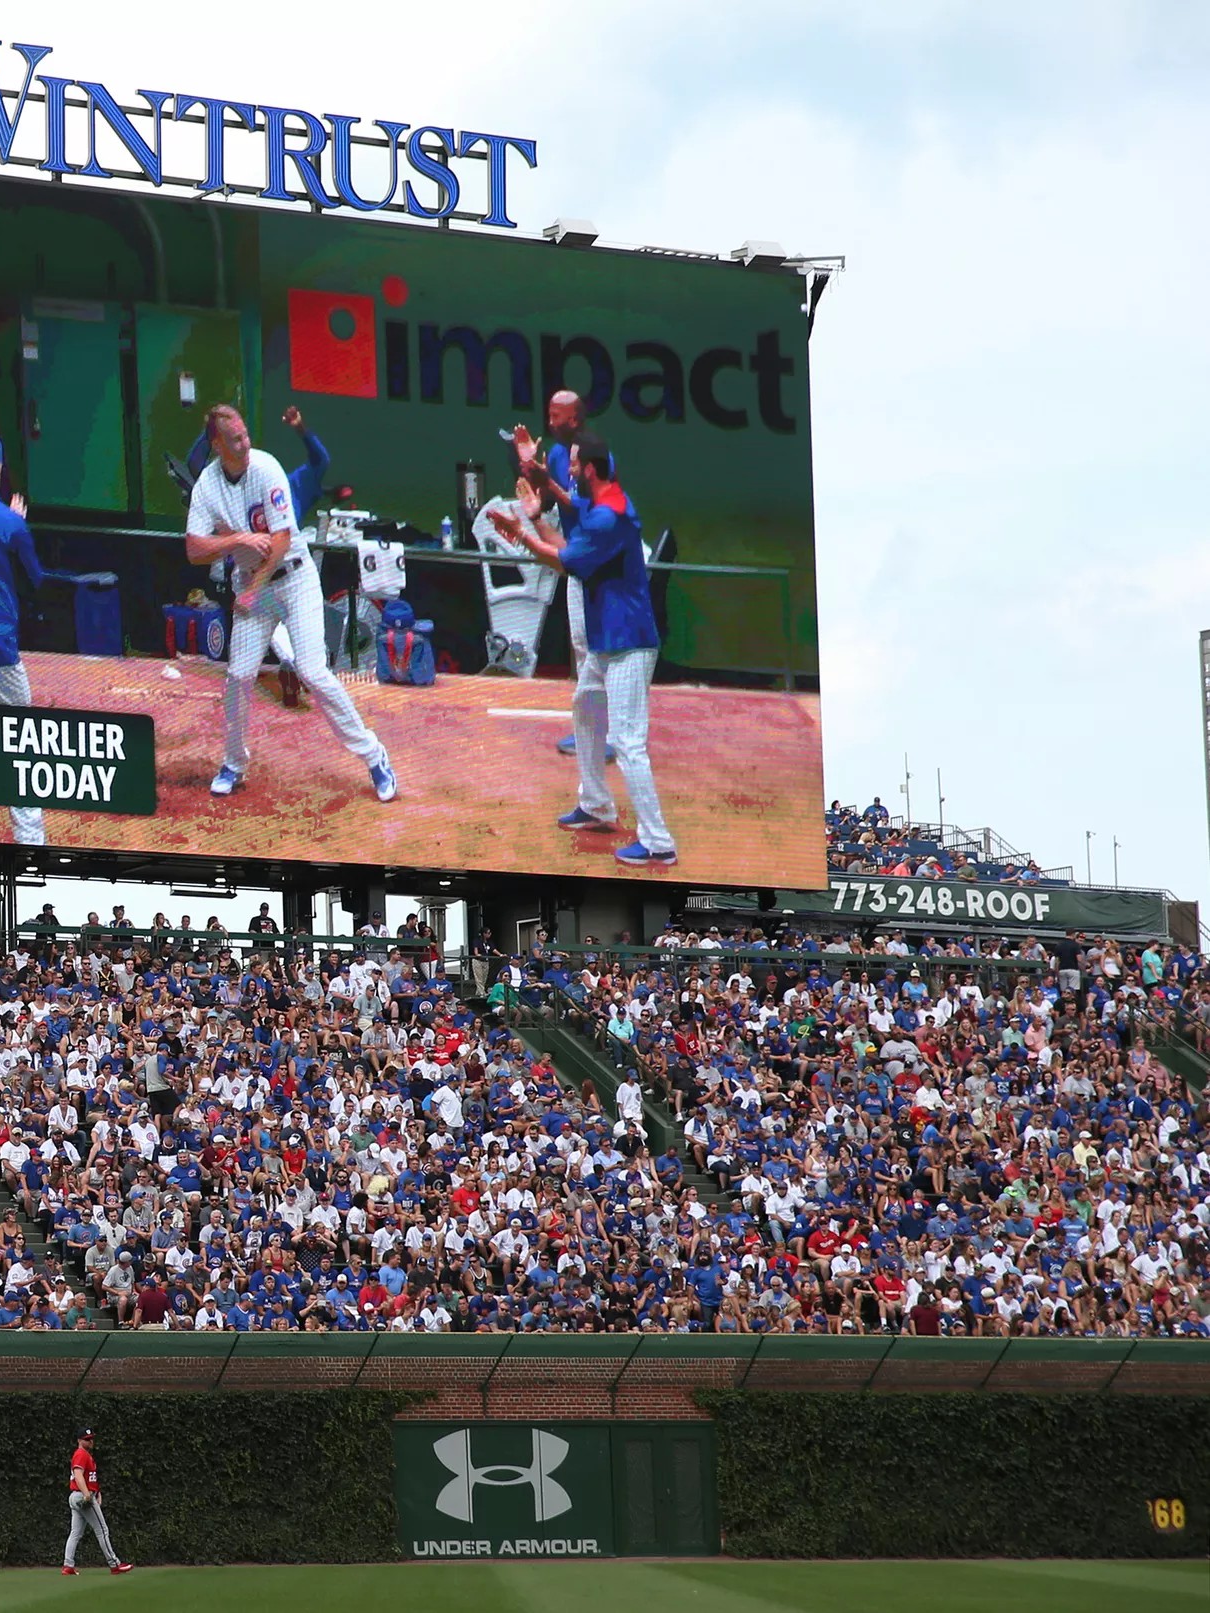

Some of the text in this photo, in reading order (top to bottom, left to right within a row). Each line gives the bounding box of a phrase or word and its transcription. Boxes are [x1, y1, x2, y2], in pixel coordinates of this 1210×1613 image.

[381, 275, 797, 437] impact
[2, 716, 126, 760] EARLIER
[13, 760, 117, 801] TODAY
[831, 882, 1050, 921] 773-248-ROOF
[1145, 1498, 1186, 1530] 68
[413, 1539, 598, 1555] UNDER ARMOUR
